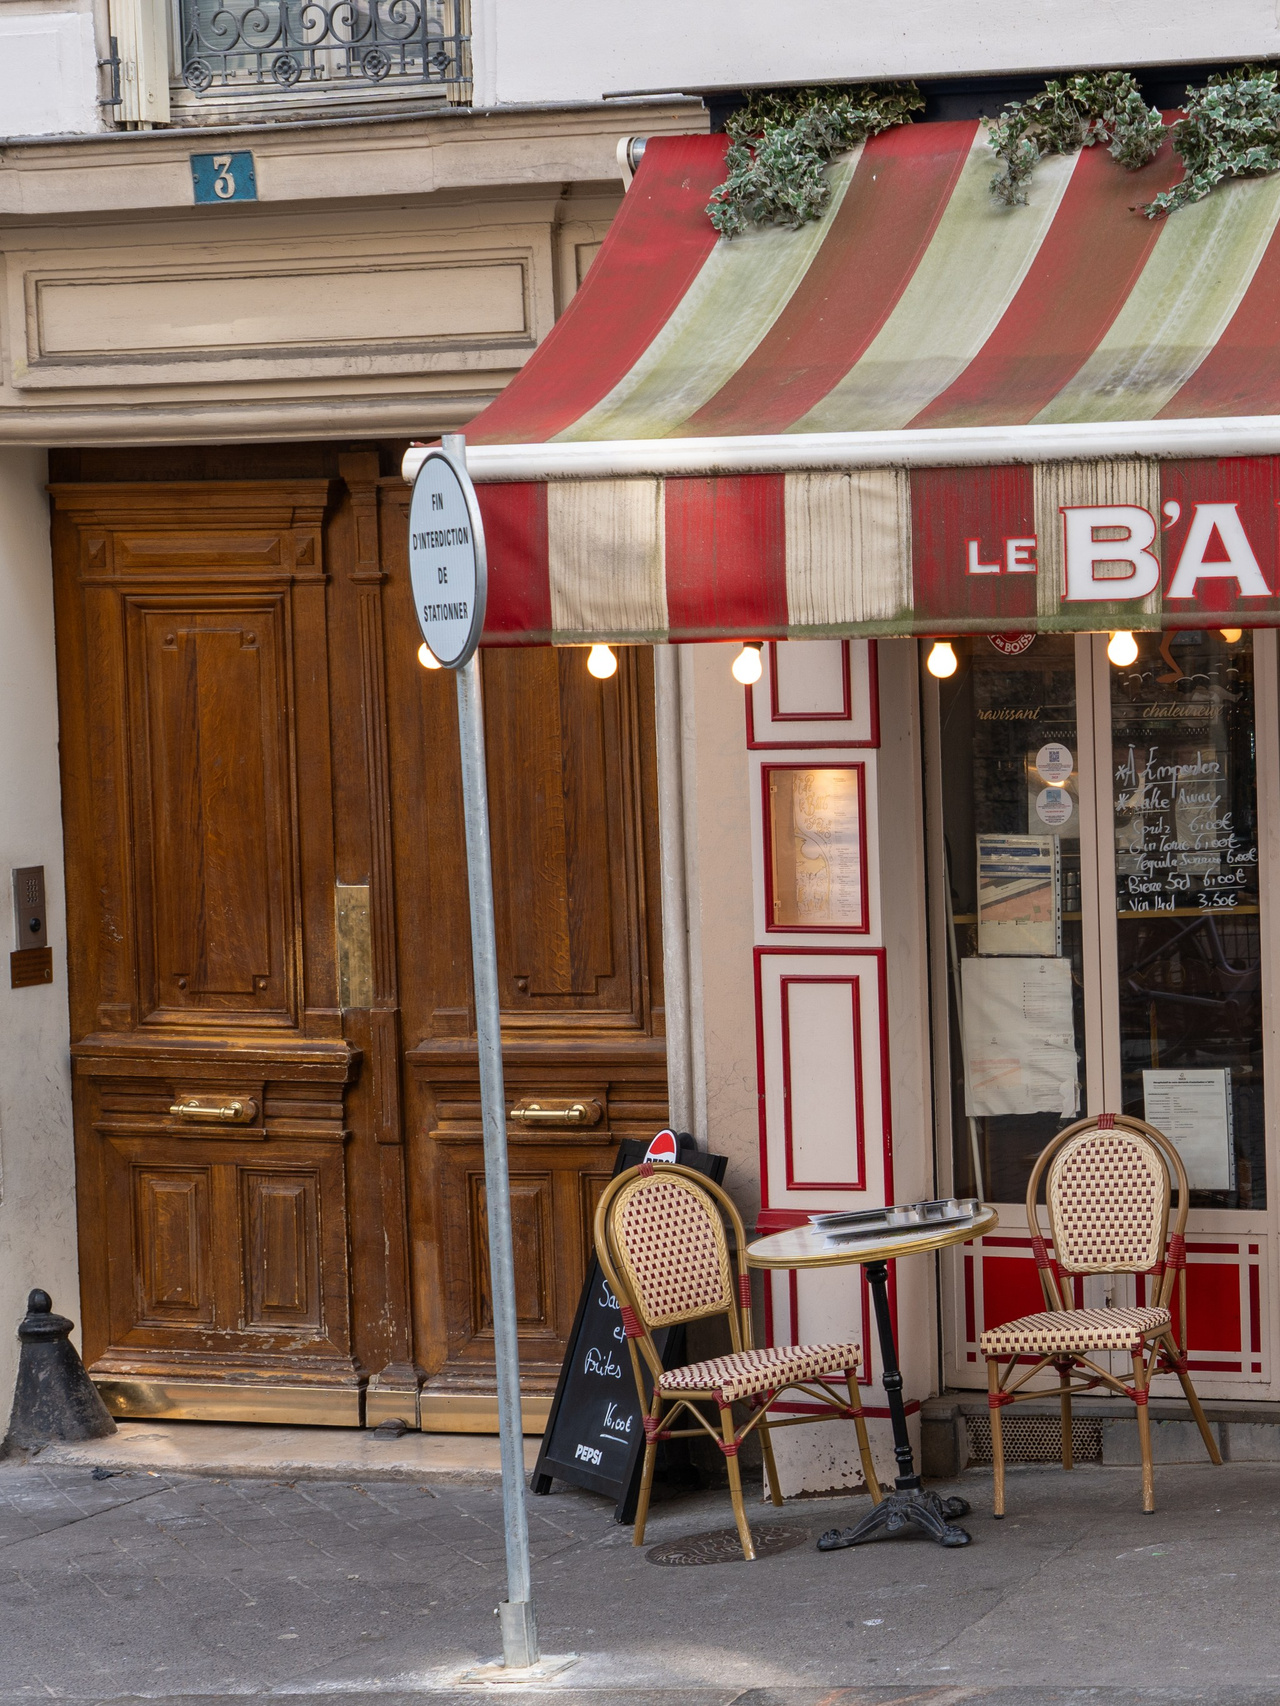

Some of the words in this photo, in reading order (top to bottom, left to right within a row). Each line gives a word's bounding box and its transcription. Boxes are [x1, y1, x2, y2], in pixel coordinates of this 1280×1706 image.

[213, 154, 236, 199] 3
[431, 493, 444, 511] FIN
[412, 526, 469, 551] D'INTERDICTION
[965, 535, 1037, 575] LE
[437, 566, 448, 585] DE
[423, 602, 469, 623] STATIONNER
[1004, 634, 1033, 652] BOISS
[976, 704, 1043, 721] ravissant
[1143, 701, 1224, 720] chaleureux
[1129, 896, 1149, 912] Vin
[575, 1444, 603, 1466] PEPSI
